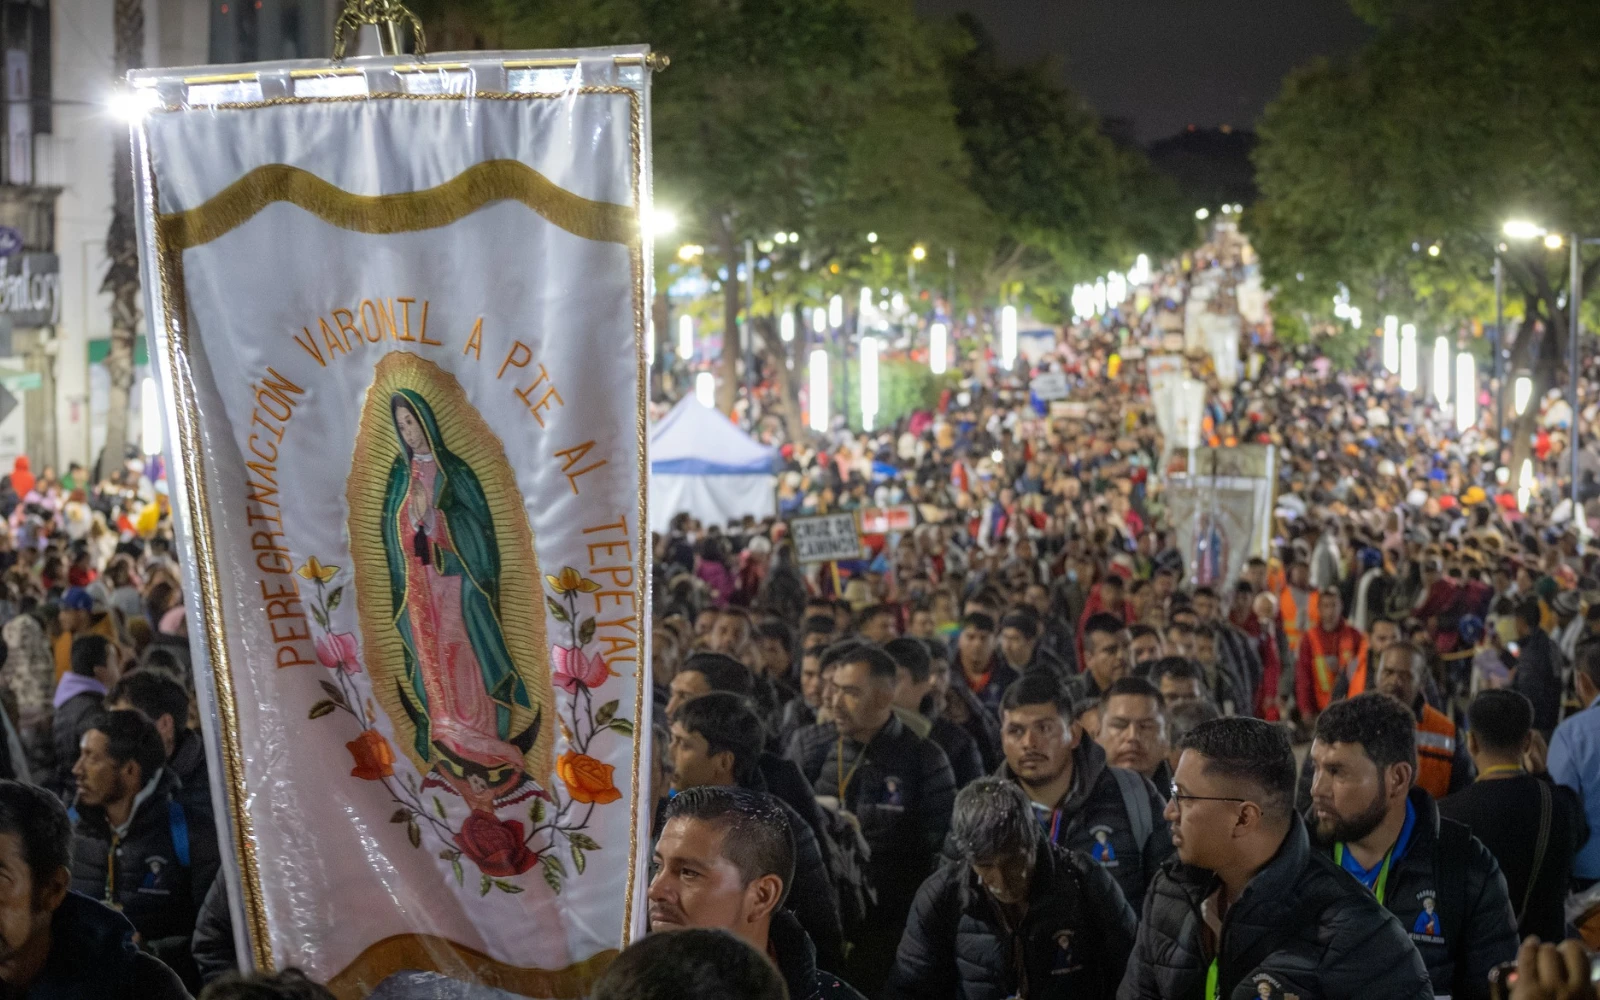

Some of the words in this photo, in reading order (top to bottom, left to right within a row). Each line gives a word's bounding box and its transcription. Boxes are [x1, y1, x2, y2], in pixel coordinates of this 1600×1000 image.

[245, 366, 316, 669] PEREGRINACIÓN
[293, 297, 444, 367] VARONIL
[463, 316, 484, 361] A
[497, 340, 565, 428] PIE
[554, 439, 608, 495] AL
